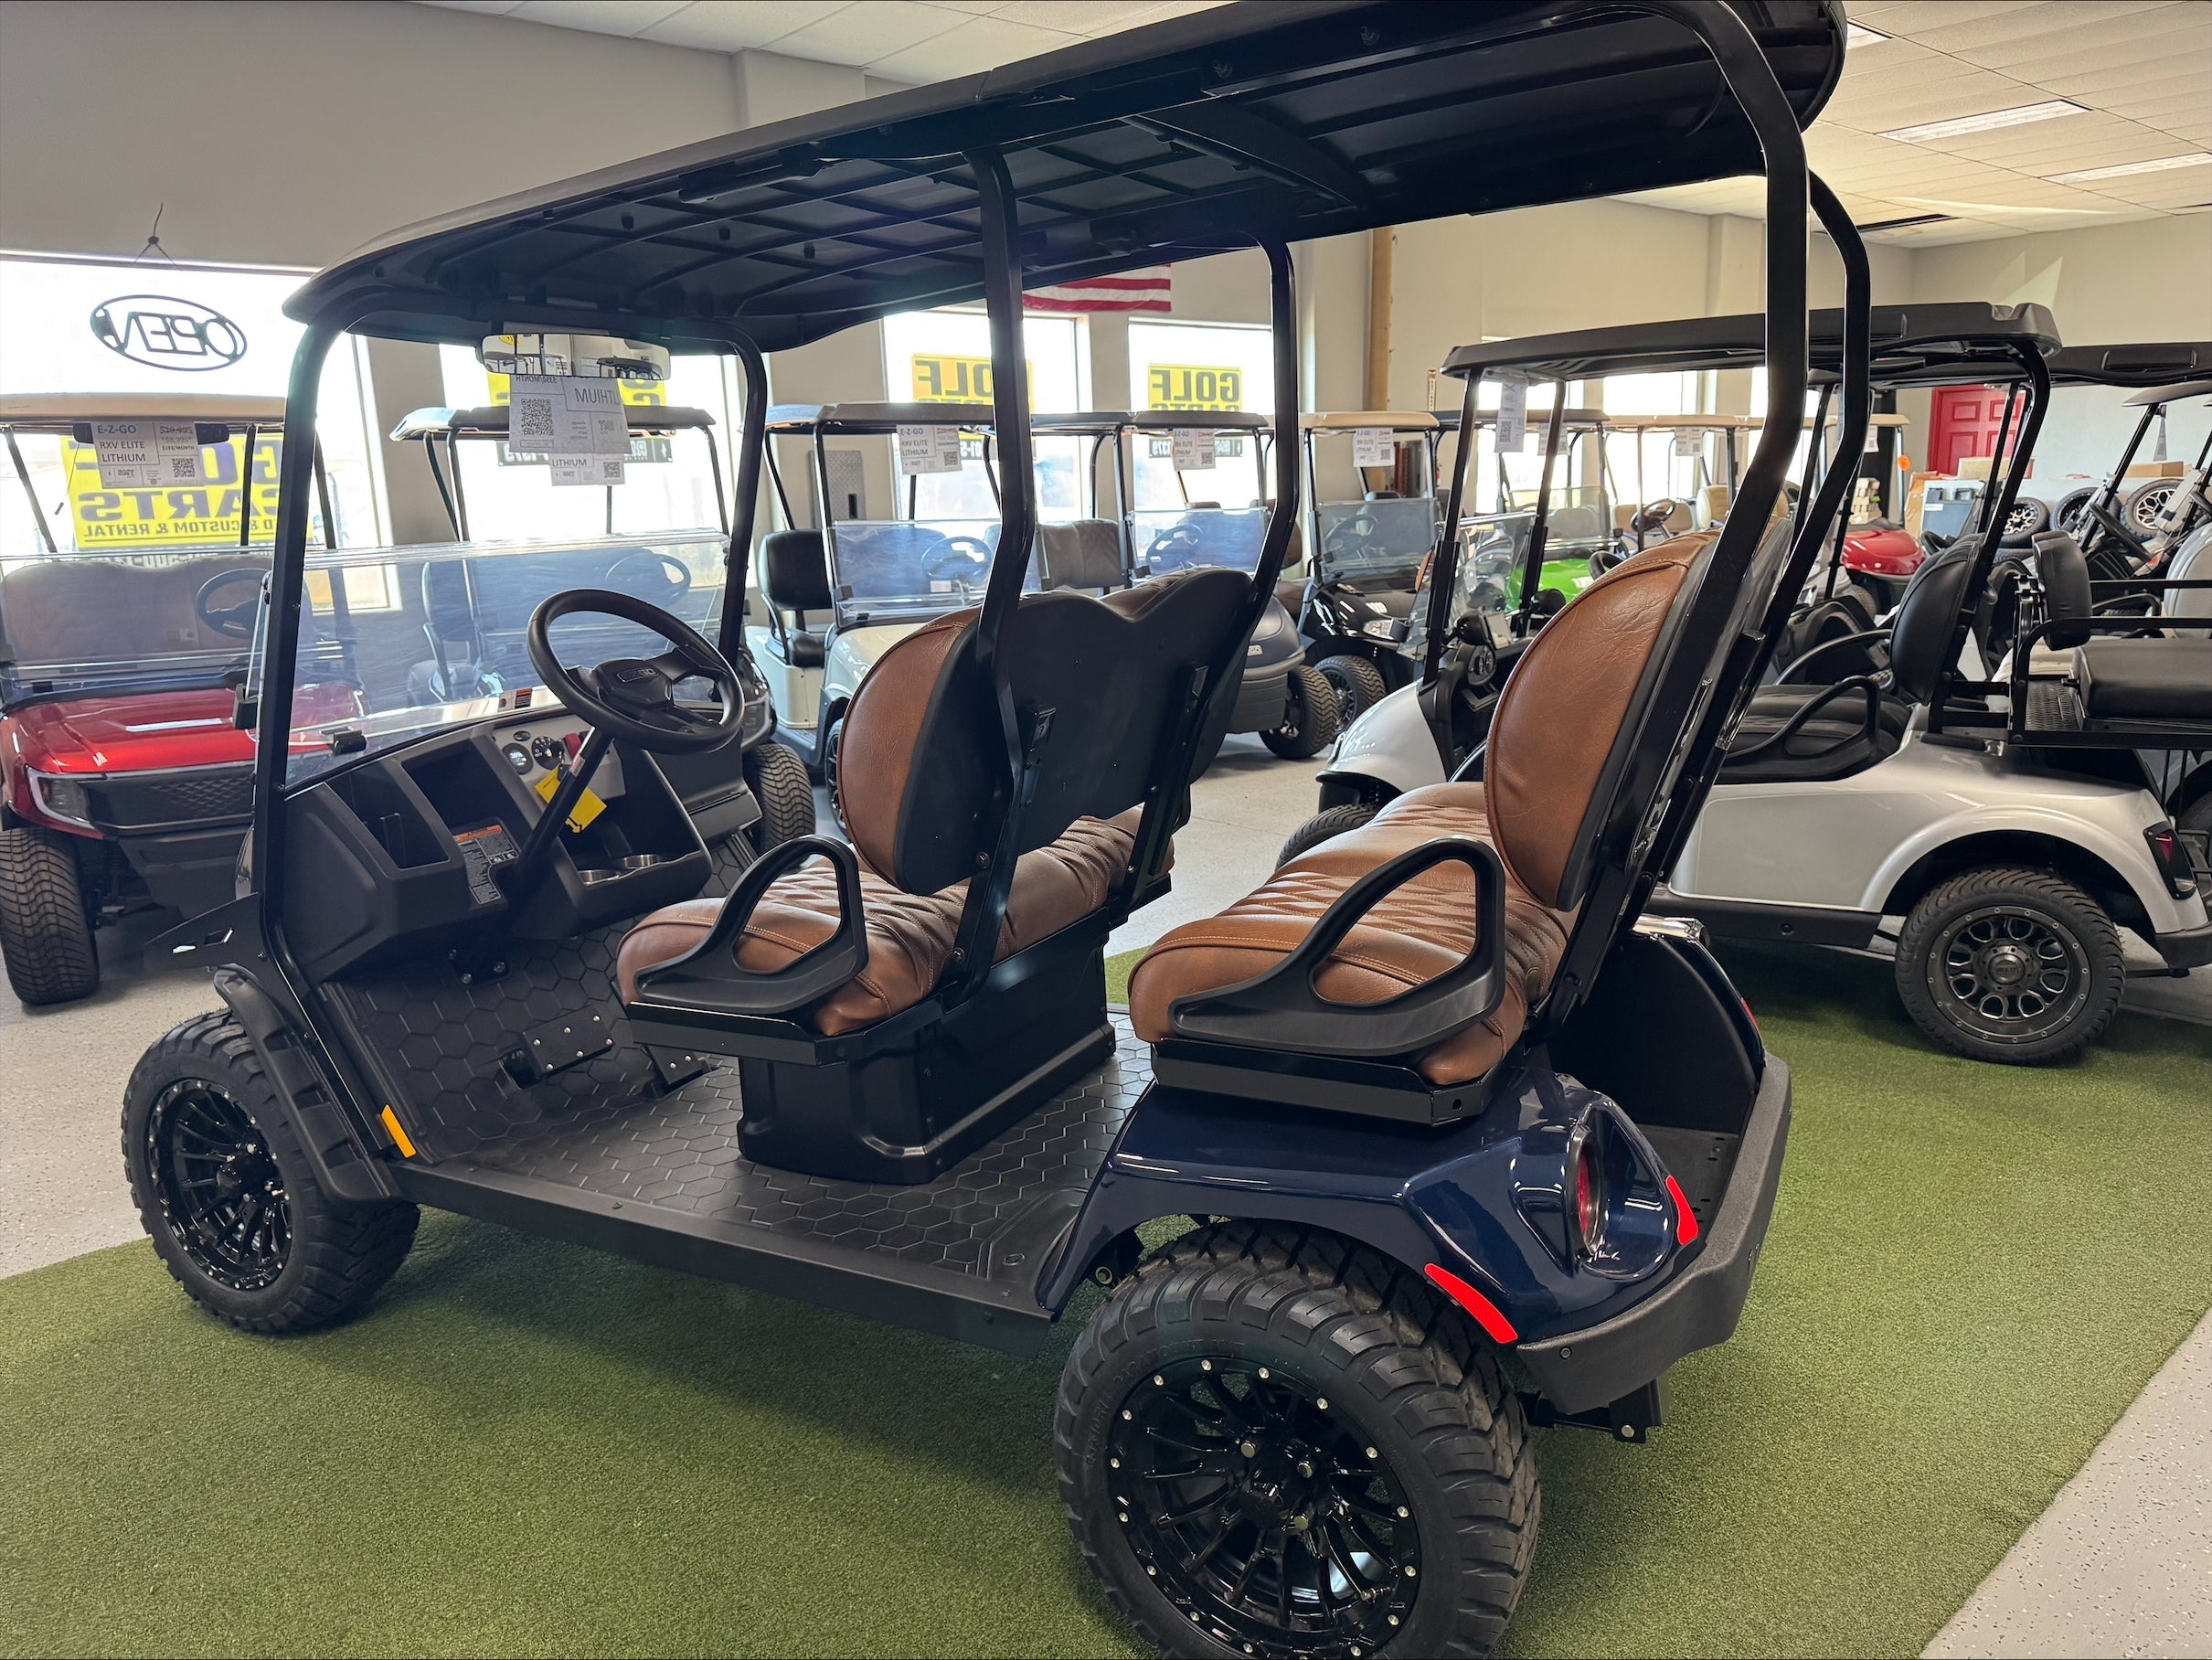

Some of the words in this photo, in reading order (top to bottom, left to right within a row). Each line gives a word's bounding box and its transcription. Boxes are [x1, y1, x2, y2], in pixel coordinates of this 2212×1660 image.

[97, 425, 137, 434] E-Z-GO
[100, 441, 118, 450] RXV
[121, 441, 145, 449] ELITE
[101, 453, 146, 463] LITHIUM
[552, 459, 587, 467] LITHIUM
